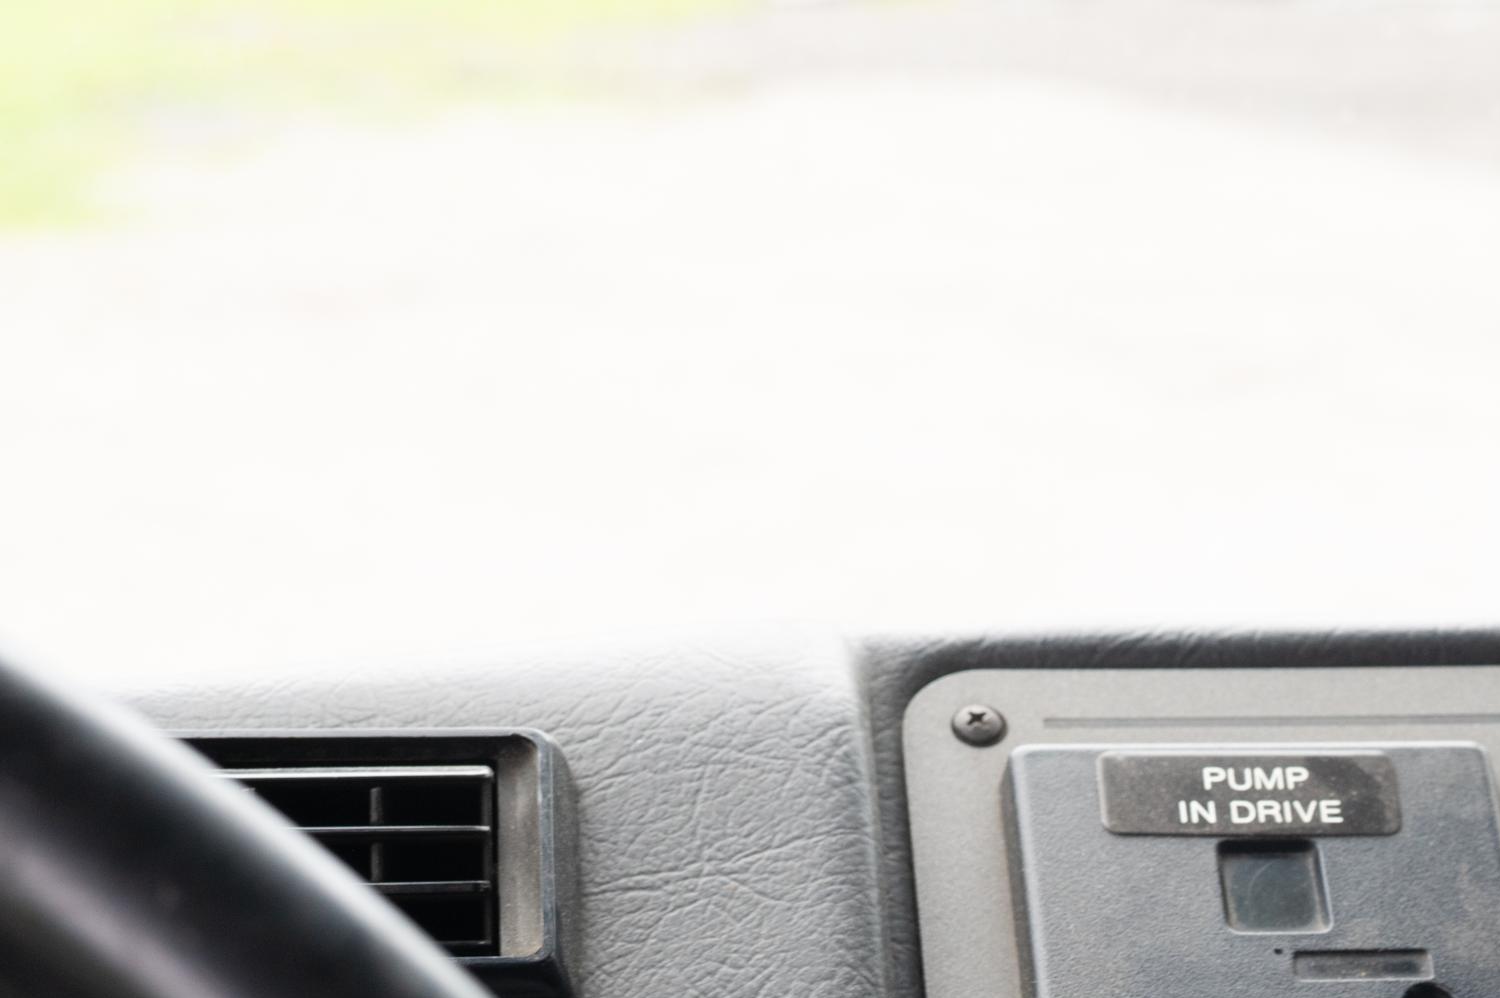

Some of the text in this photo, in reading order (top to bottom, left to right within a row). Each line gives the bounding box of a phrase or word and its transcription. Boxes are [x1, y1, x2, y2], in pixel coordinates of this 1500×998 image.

[1202, 766, 1309, 791] PUMP
[1178, 800, 1344, 824] IN DRIVE
